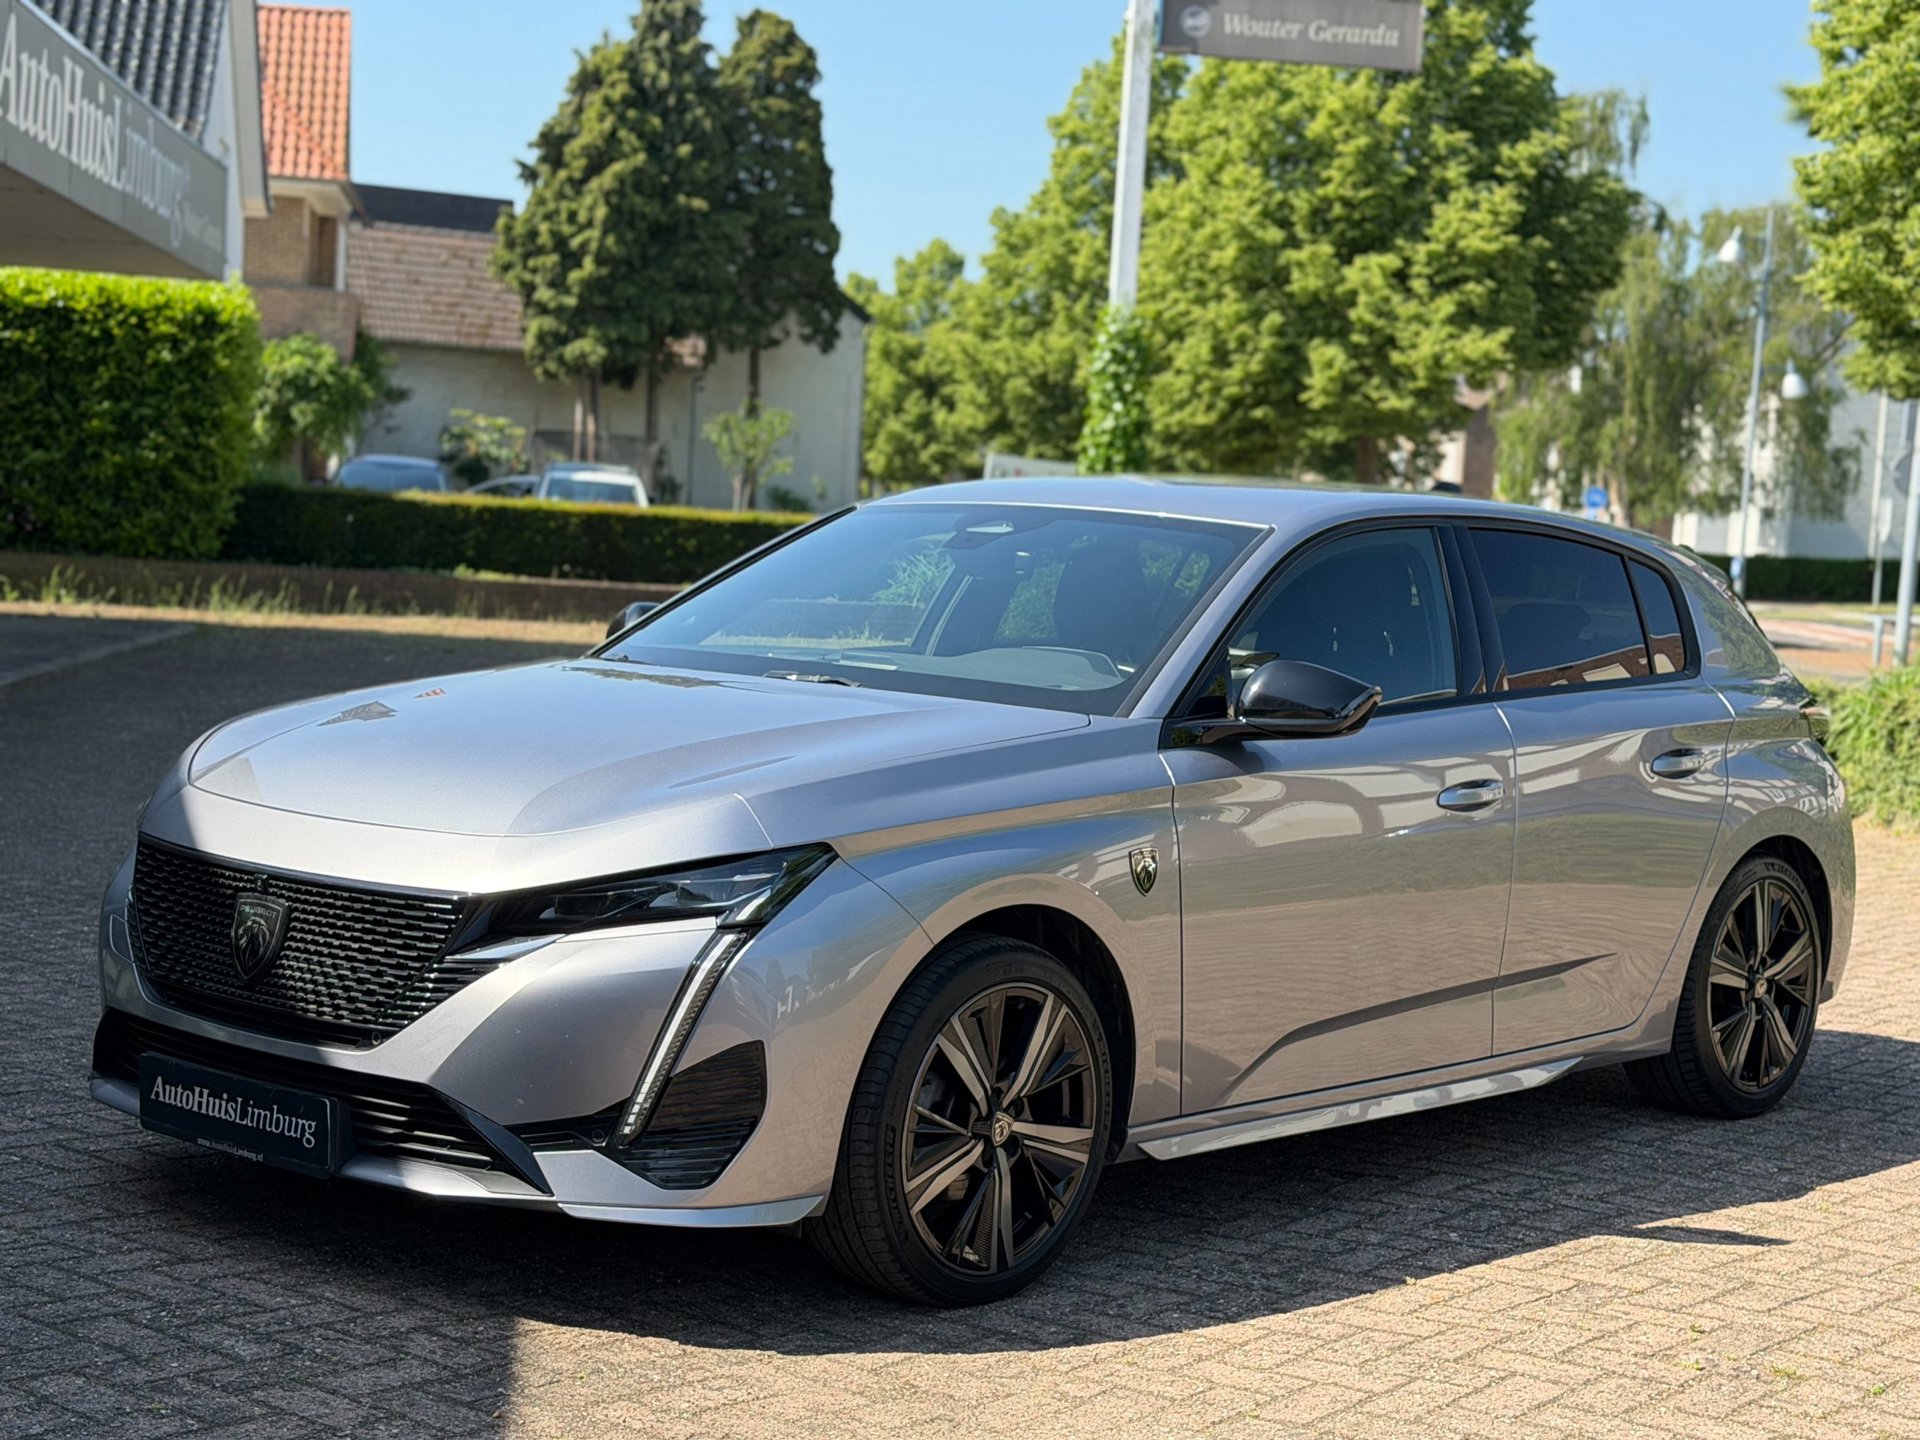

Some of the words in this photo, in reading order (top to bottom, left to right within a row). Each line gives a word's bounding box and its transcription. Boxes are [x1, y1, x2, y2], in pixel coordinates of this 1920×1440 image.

[1224, 14, 1302, 39] Wouter
[240, 904, 277, 918] PEUGEOT
[151, 1076, 316, 1148] AutoHuisLimburg
